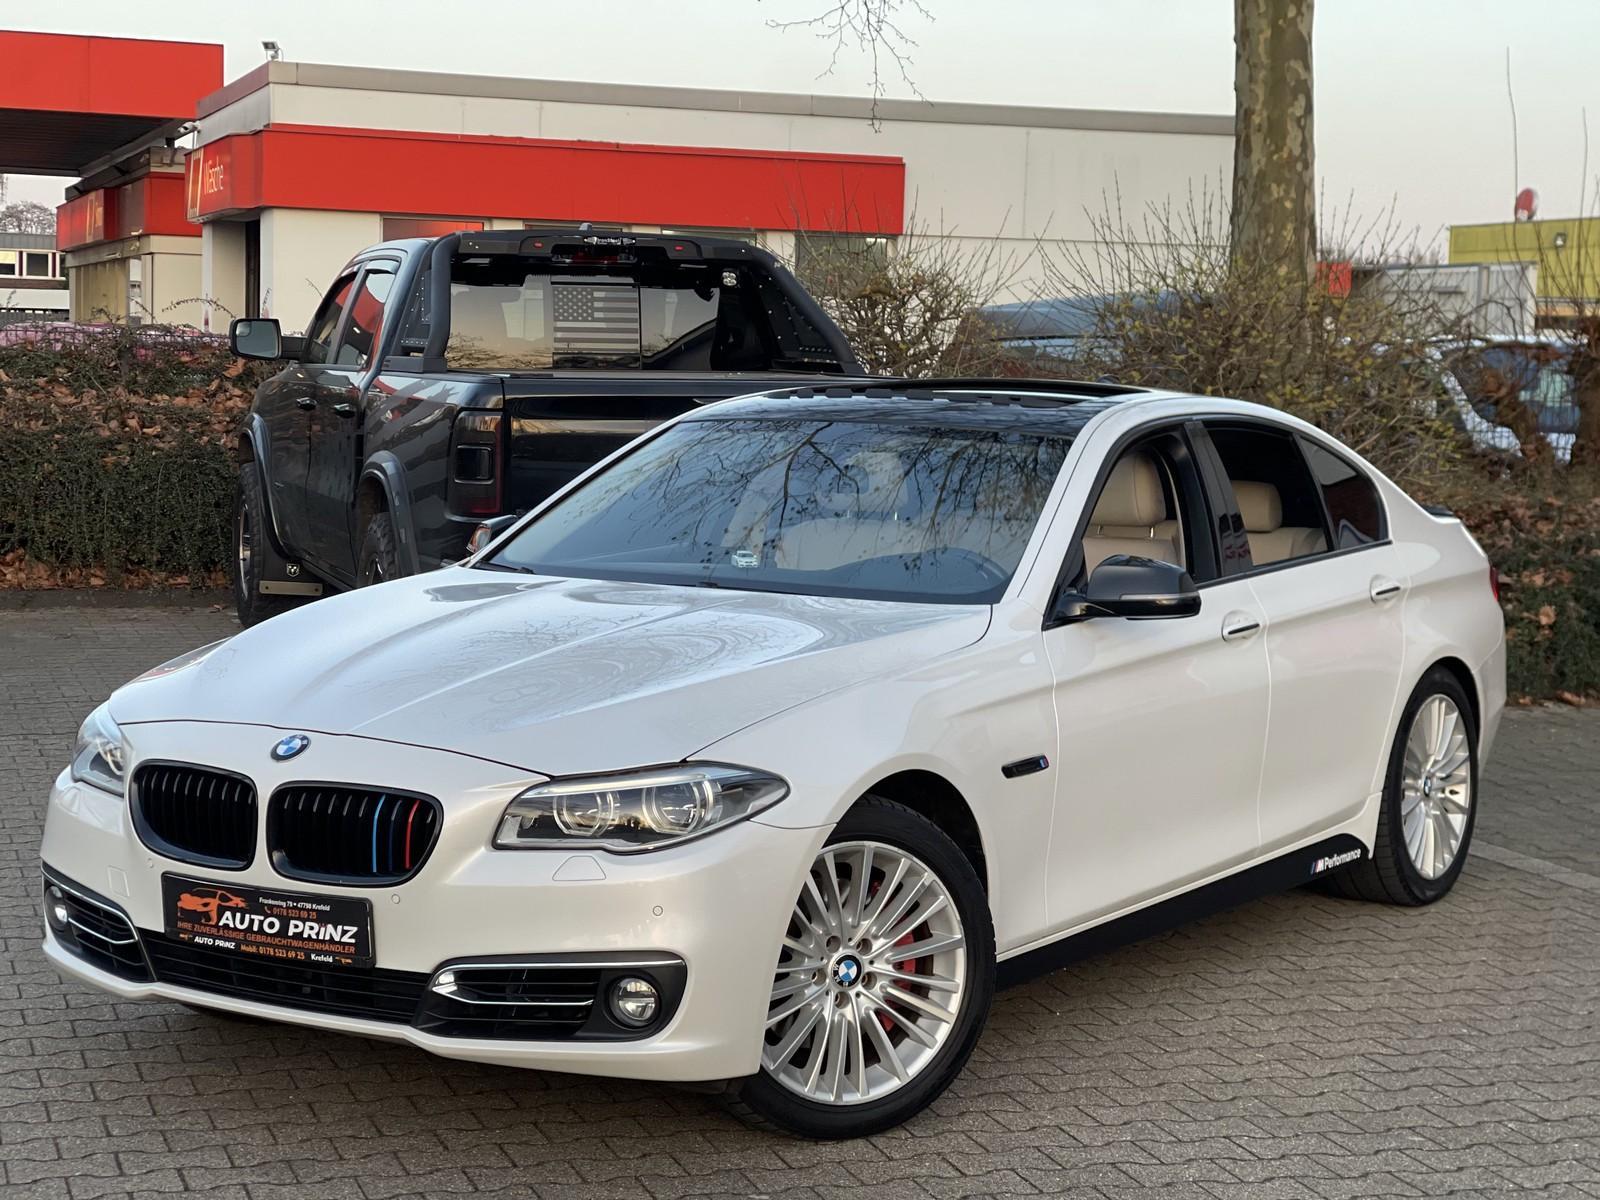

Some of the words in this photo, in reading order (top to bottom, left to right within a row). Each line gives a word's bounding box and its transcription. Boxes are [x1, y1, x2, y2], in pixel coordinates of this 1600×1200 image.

[312, 903, 331, 911] Krefeld
[177, 921, 193, 932] IHRE
[193, 924, 245, 940] ZUVERLÄSSIGE
[218, 911, 281, 933] AUTO
[194, 936, 213, 945] AUTO
[258, 946, 274, 955] 0178
[275, 949, 287, 957] 523
[287, 950, 297, 958] 69
[297, 951, 305, 960] 25
[311, 953, 333, 963] Krefeld
